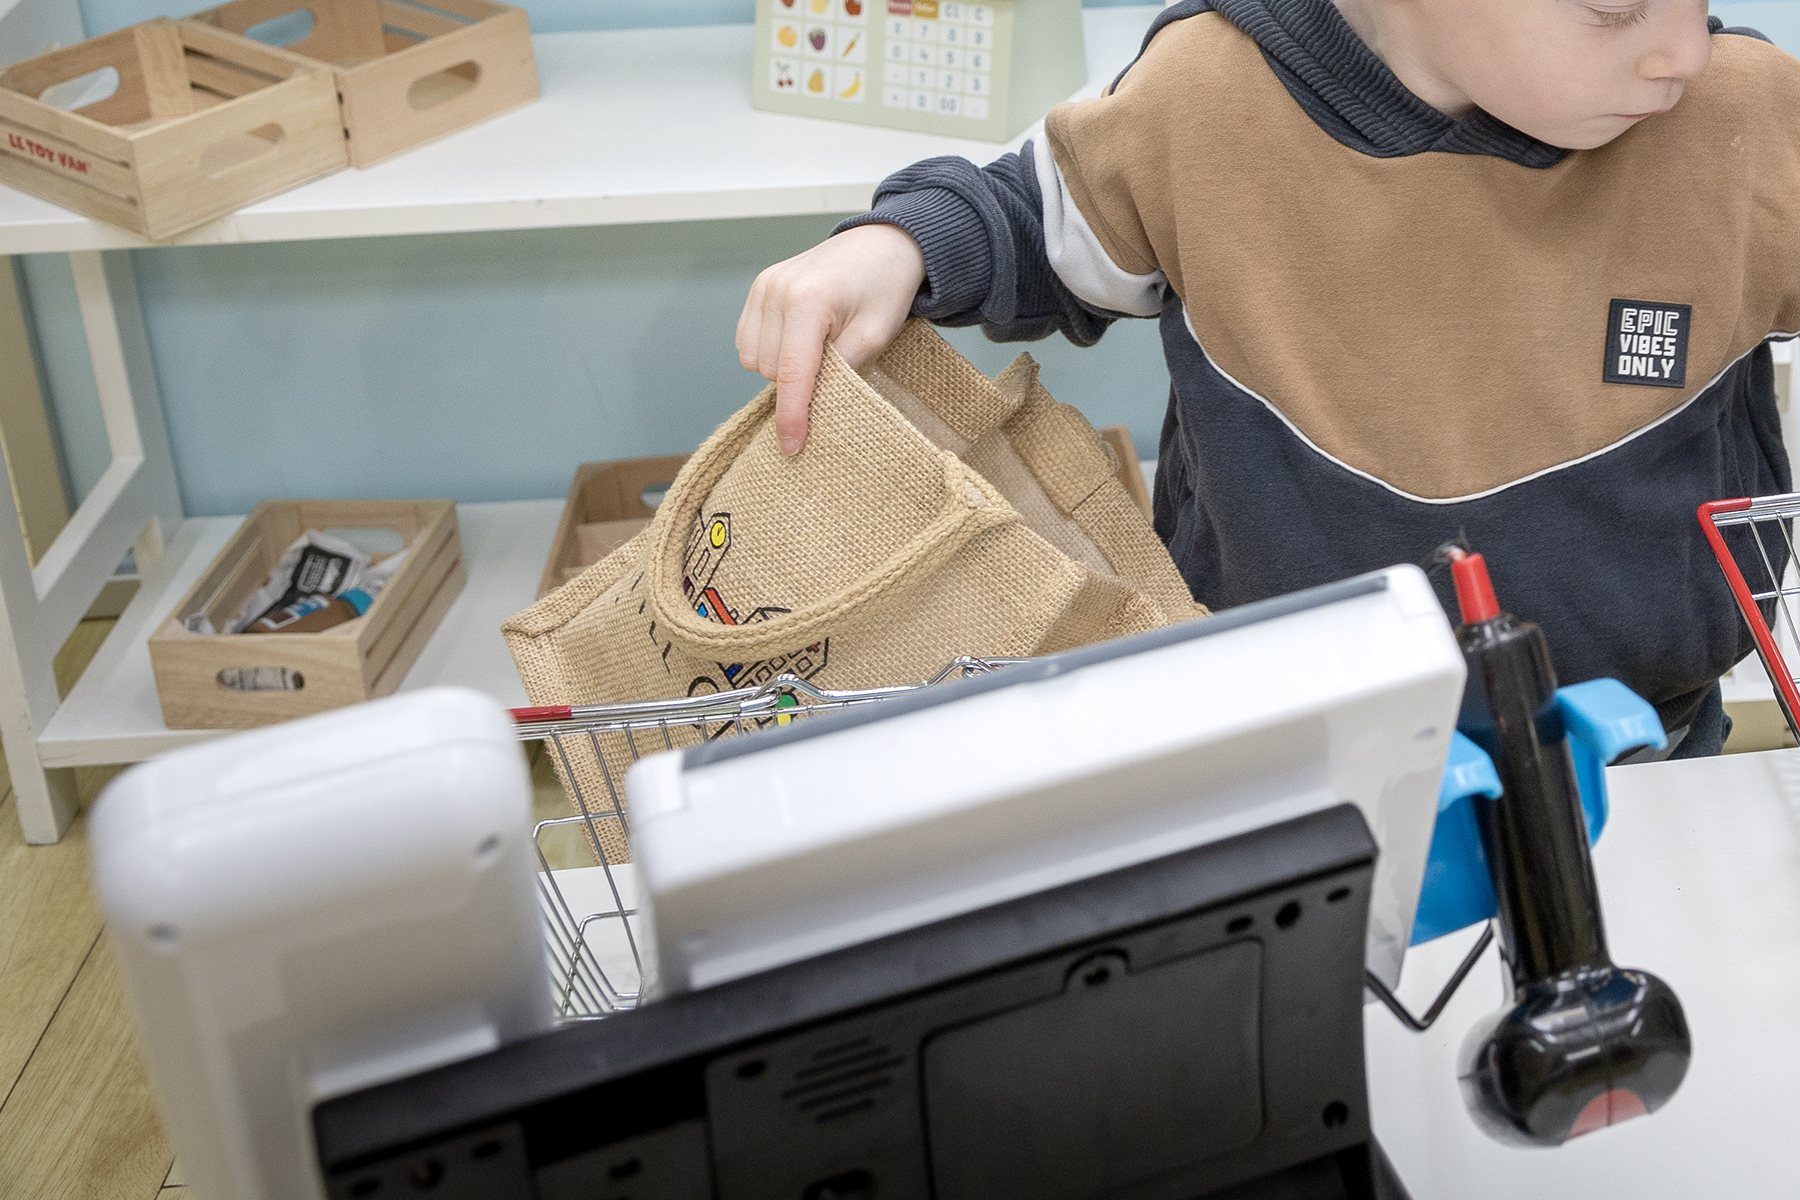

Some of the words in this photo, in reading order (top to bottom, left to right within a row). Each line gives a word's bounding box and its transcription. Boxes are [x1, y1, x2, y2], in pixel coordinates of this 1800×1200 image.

[25, 139, 55, 163] TOY
[1620, 307, 1680, 336] EPIC
[1619, 333, 1677, 357] VIBES
[1617, 354, 1675, 379] ONLY
